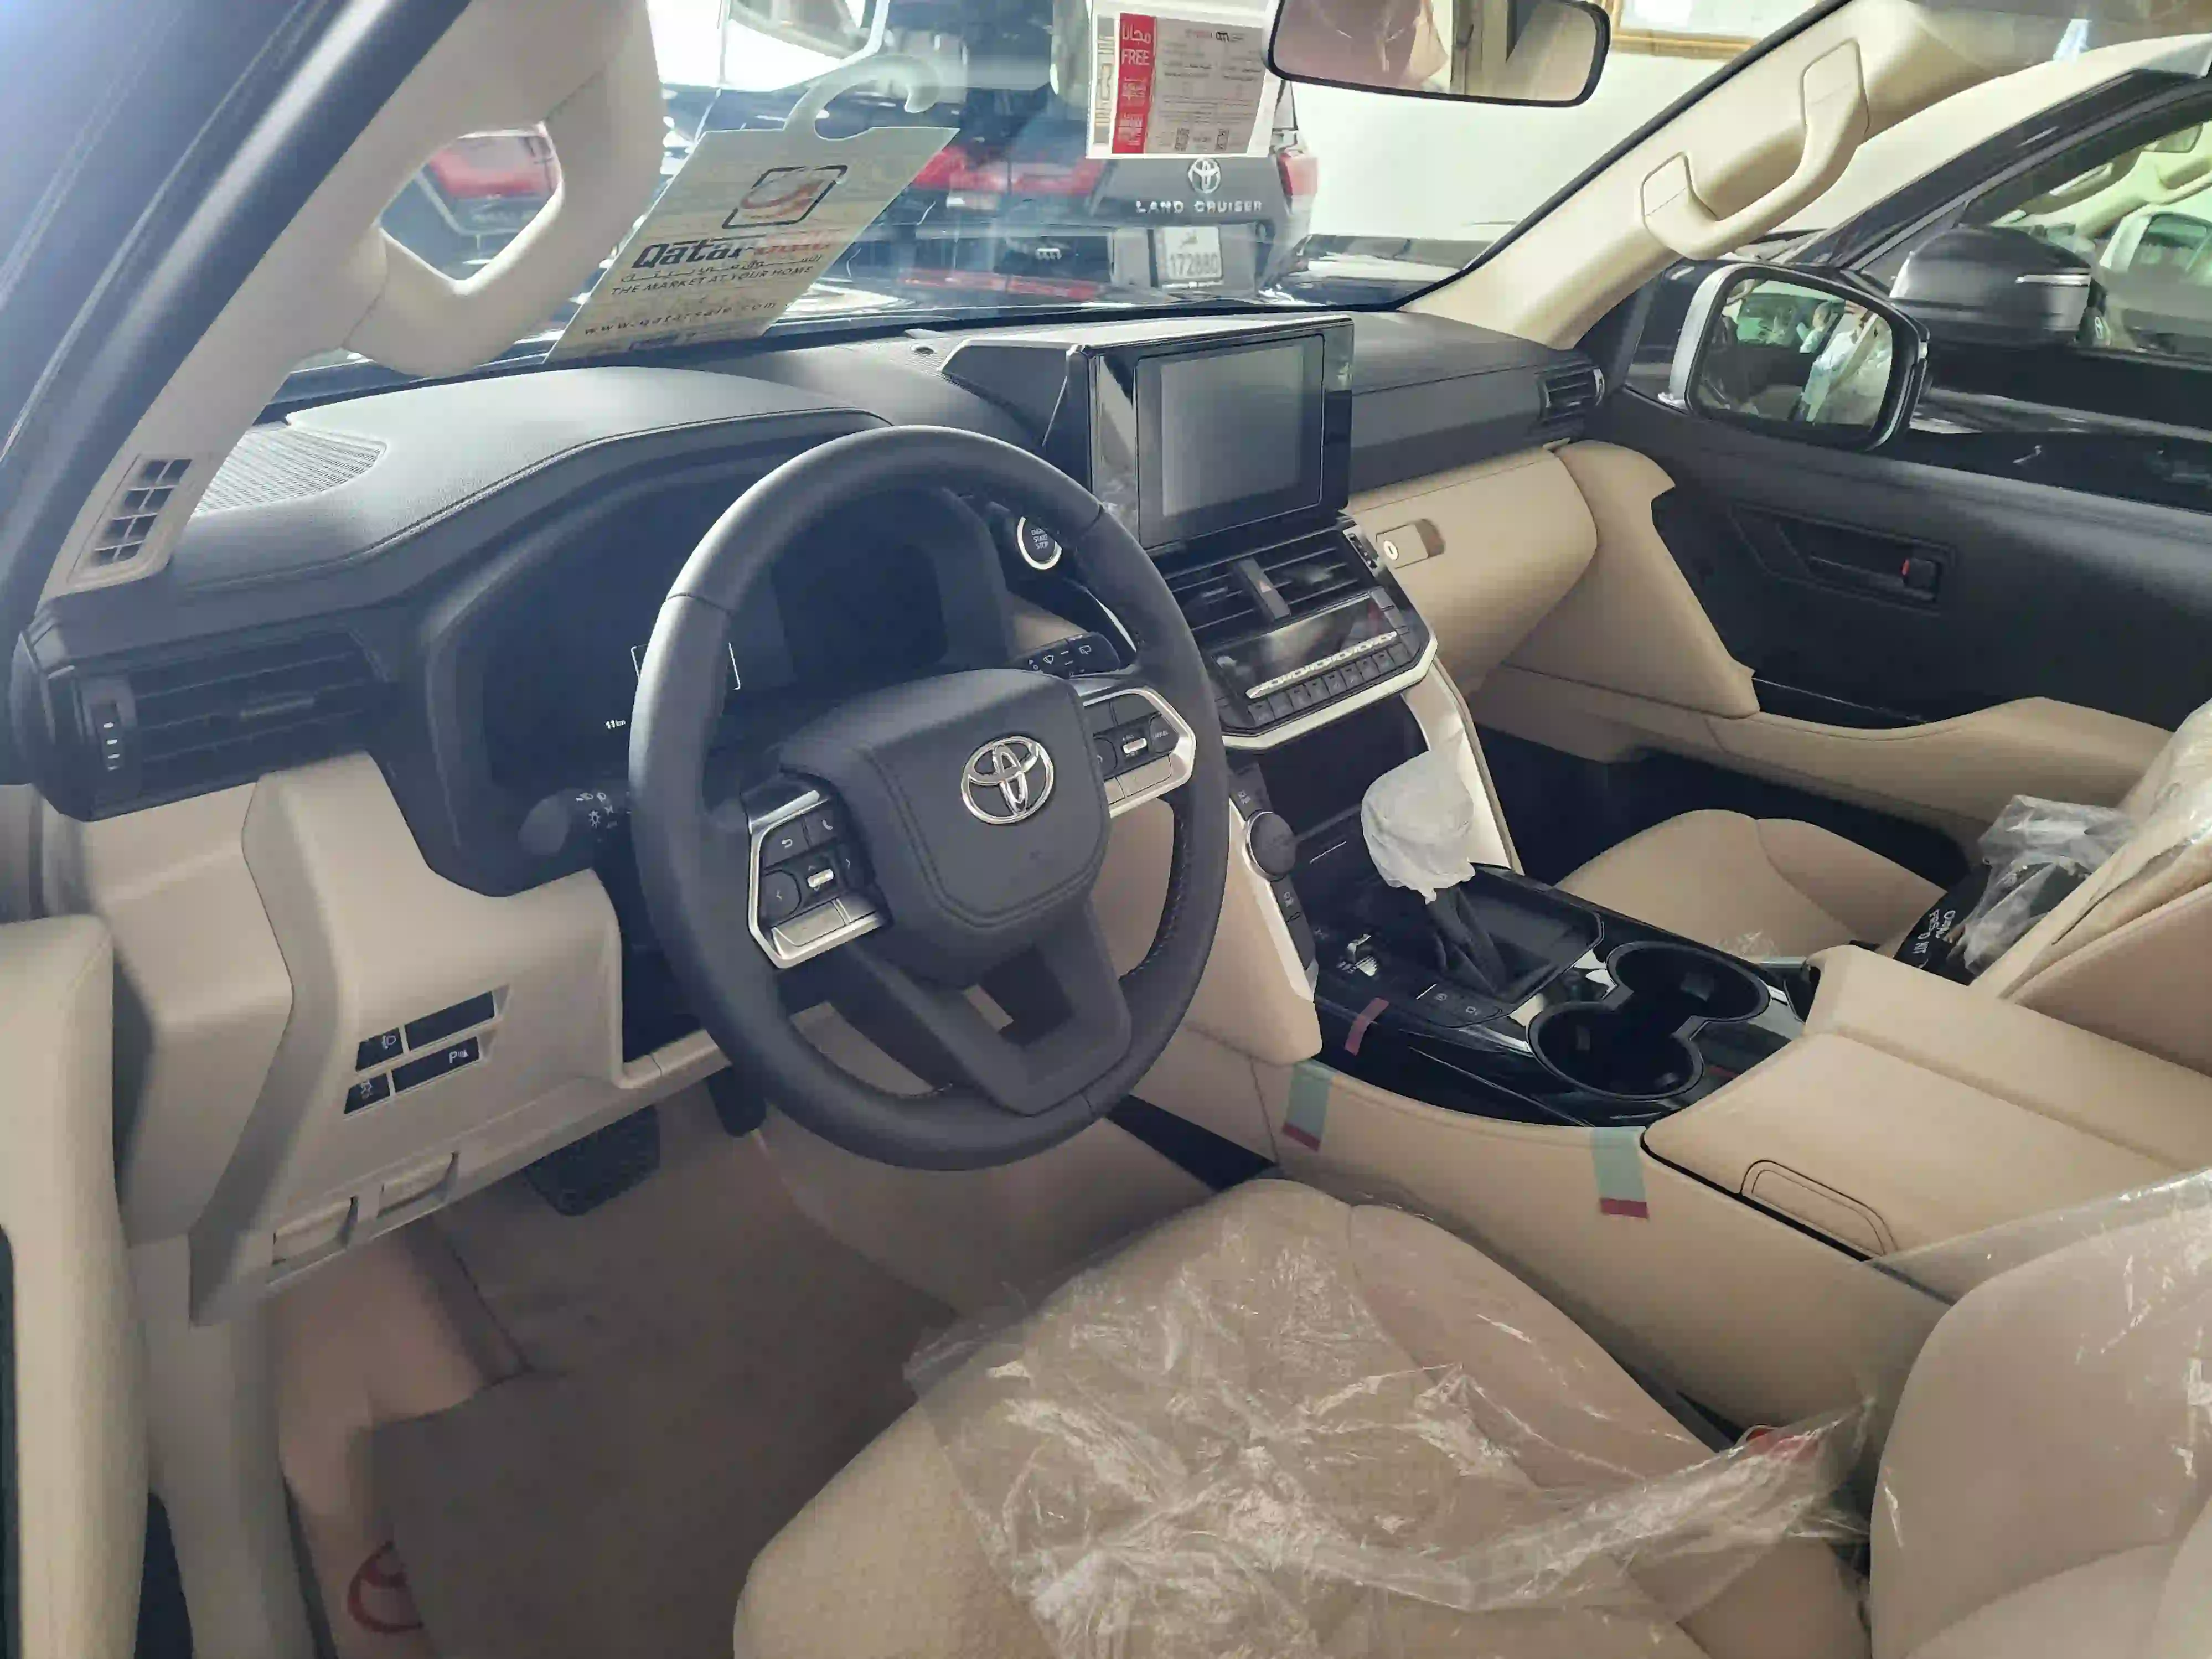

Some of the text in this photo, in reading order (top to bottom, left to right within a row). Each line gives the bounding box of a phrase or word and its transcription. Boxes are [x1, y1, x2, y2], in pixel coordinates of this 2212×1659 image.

[1121, 48, 1150, 66] FREE
[1135, 200, 1262, 214] LAND CRUISER
[611, 265, 814, 296] THE MARKET AT YOUR HOME
[1033, 534, 1048, 543] START
[1036, 541, 1049, 550] STOP
